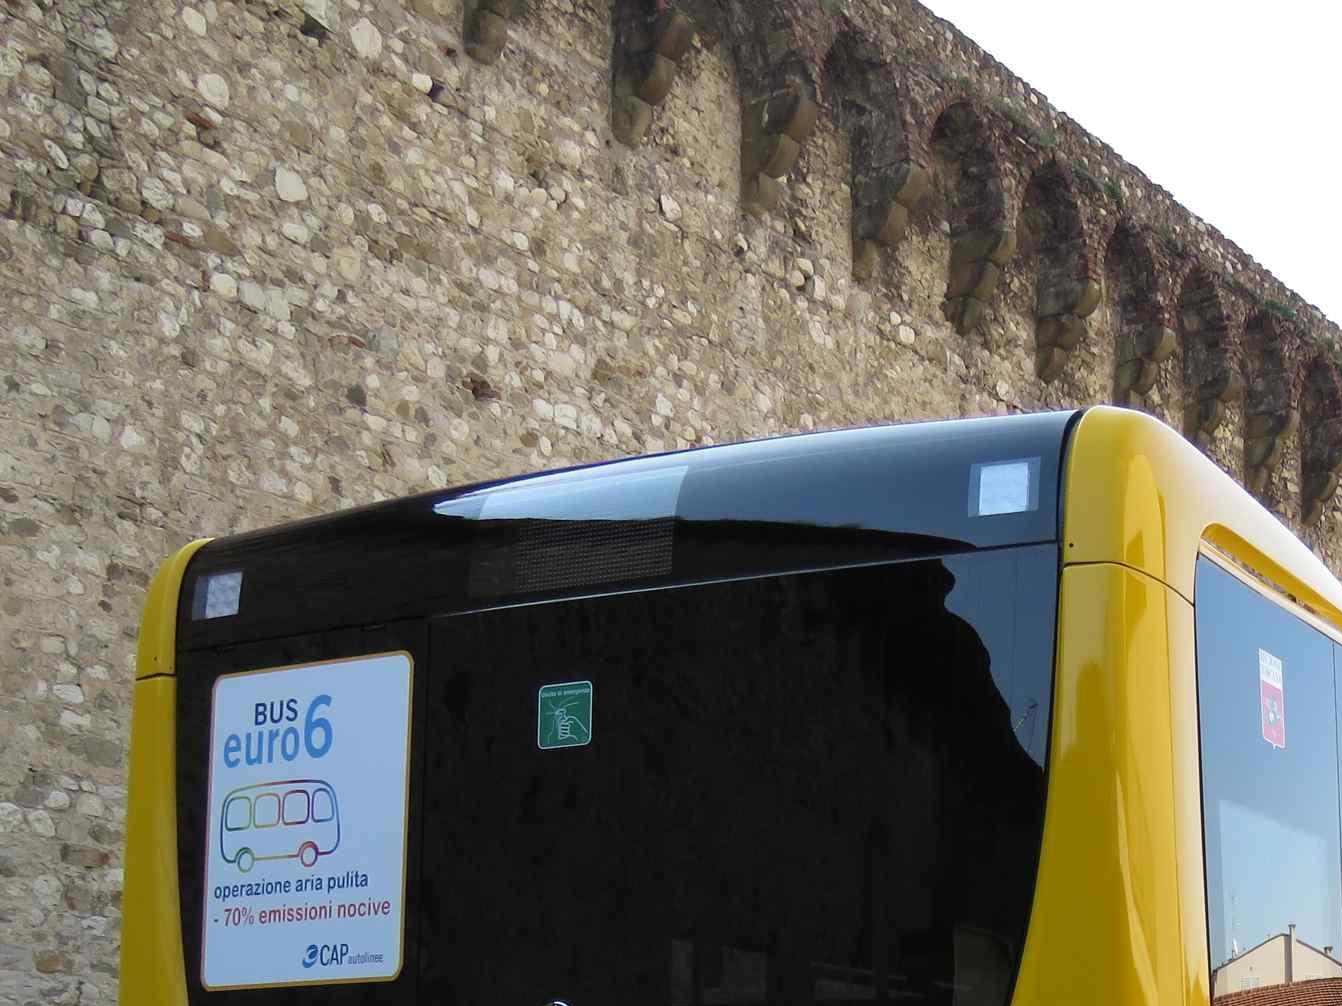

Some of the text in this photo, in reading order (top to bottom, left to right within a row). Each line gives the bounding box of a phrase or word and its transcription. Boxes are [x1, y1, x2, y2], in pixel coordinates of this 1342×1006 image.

[254, 698, 299, 728] BUS
[213, 871, 369, 901] operazione aria pulita
[223, 906, 255, 928] 70%
[258, 900, 333, 925] emissioni
[336, 898, 391, 918] nocive
[319, 943, 384, 967] CAP autolinee
